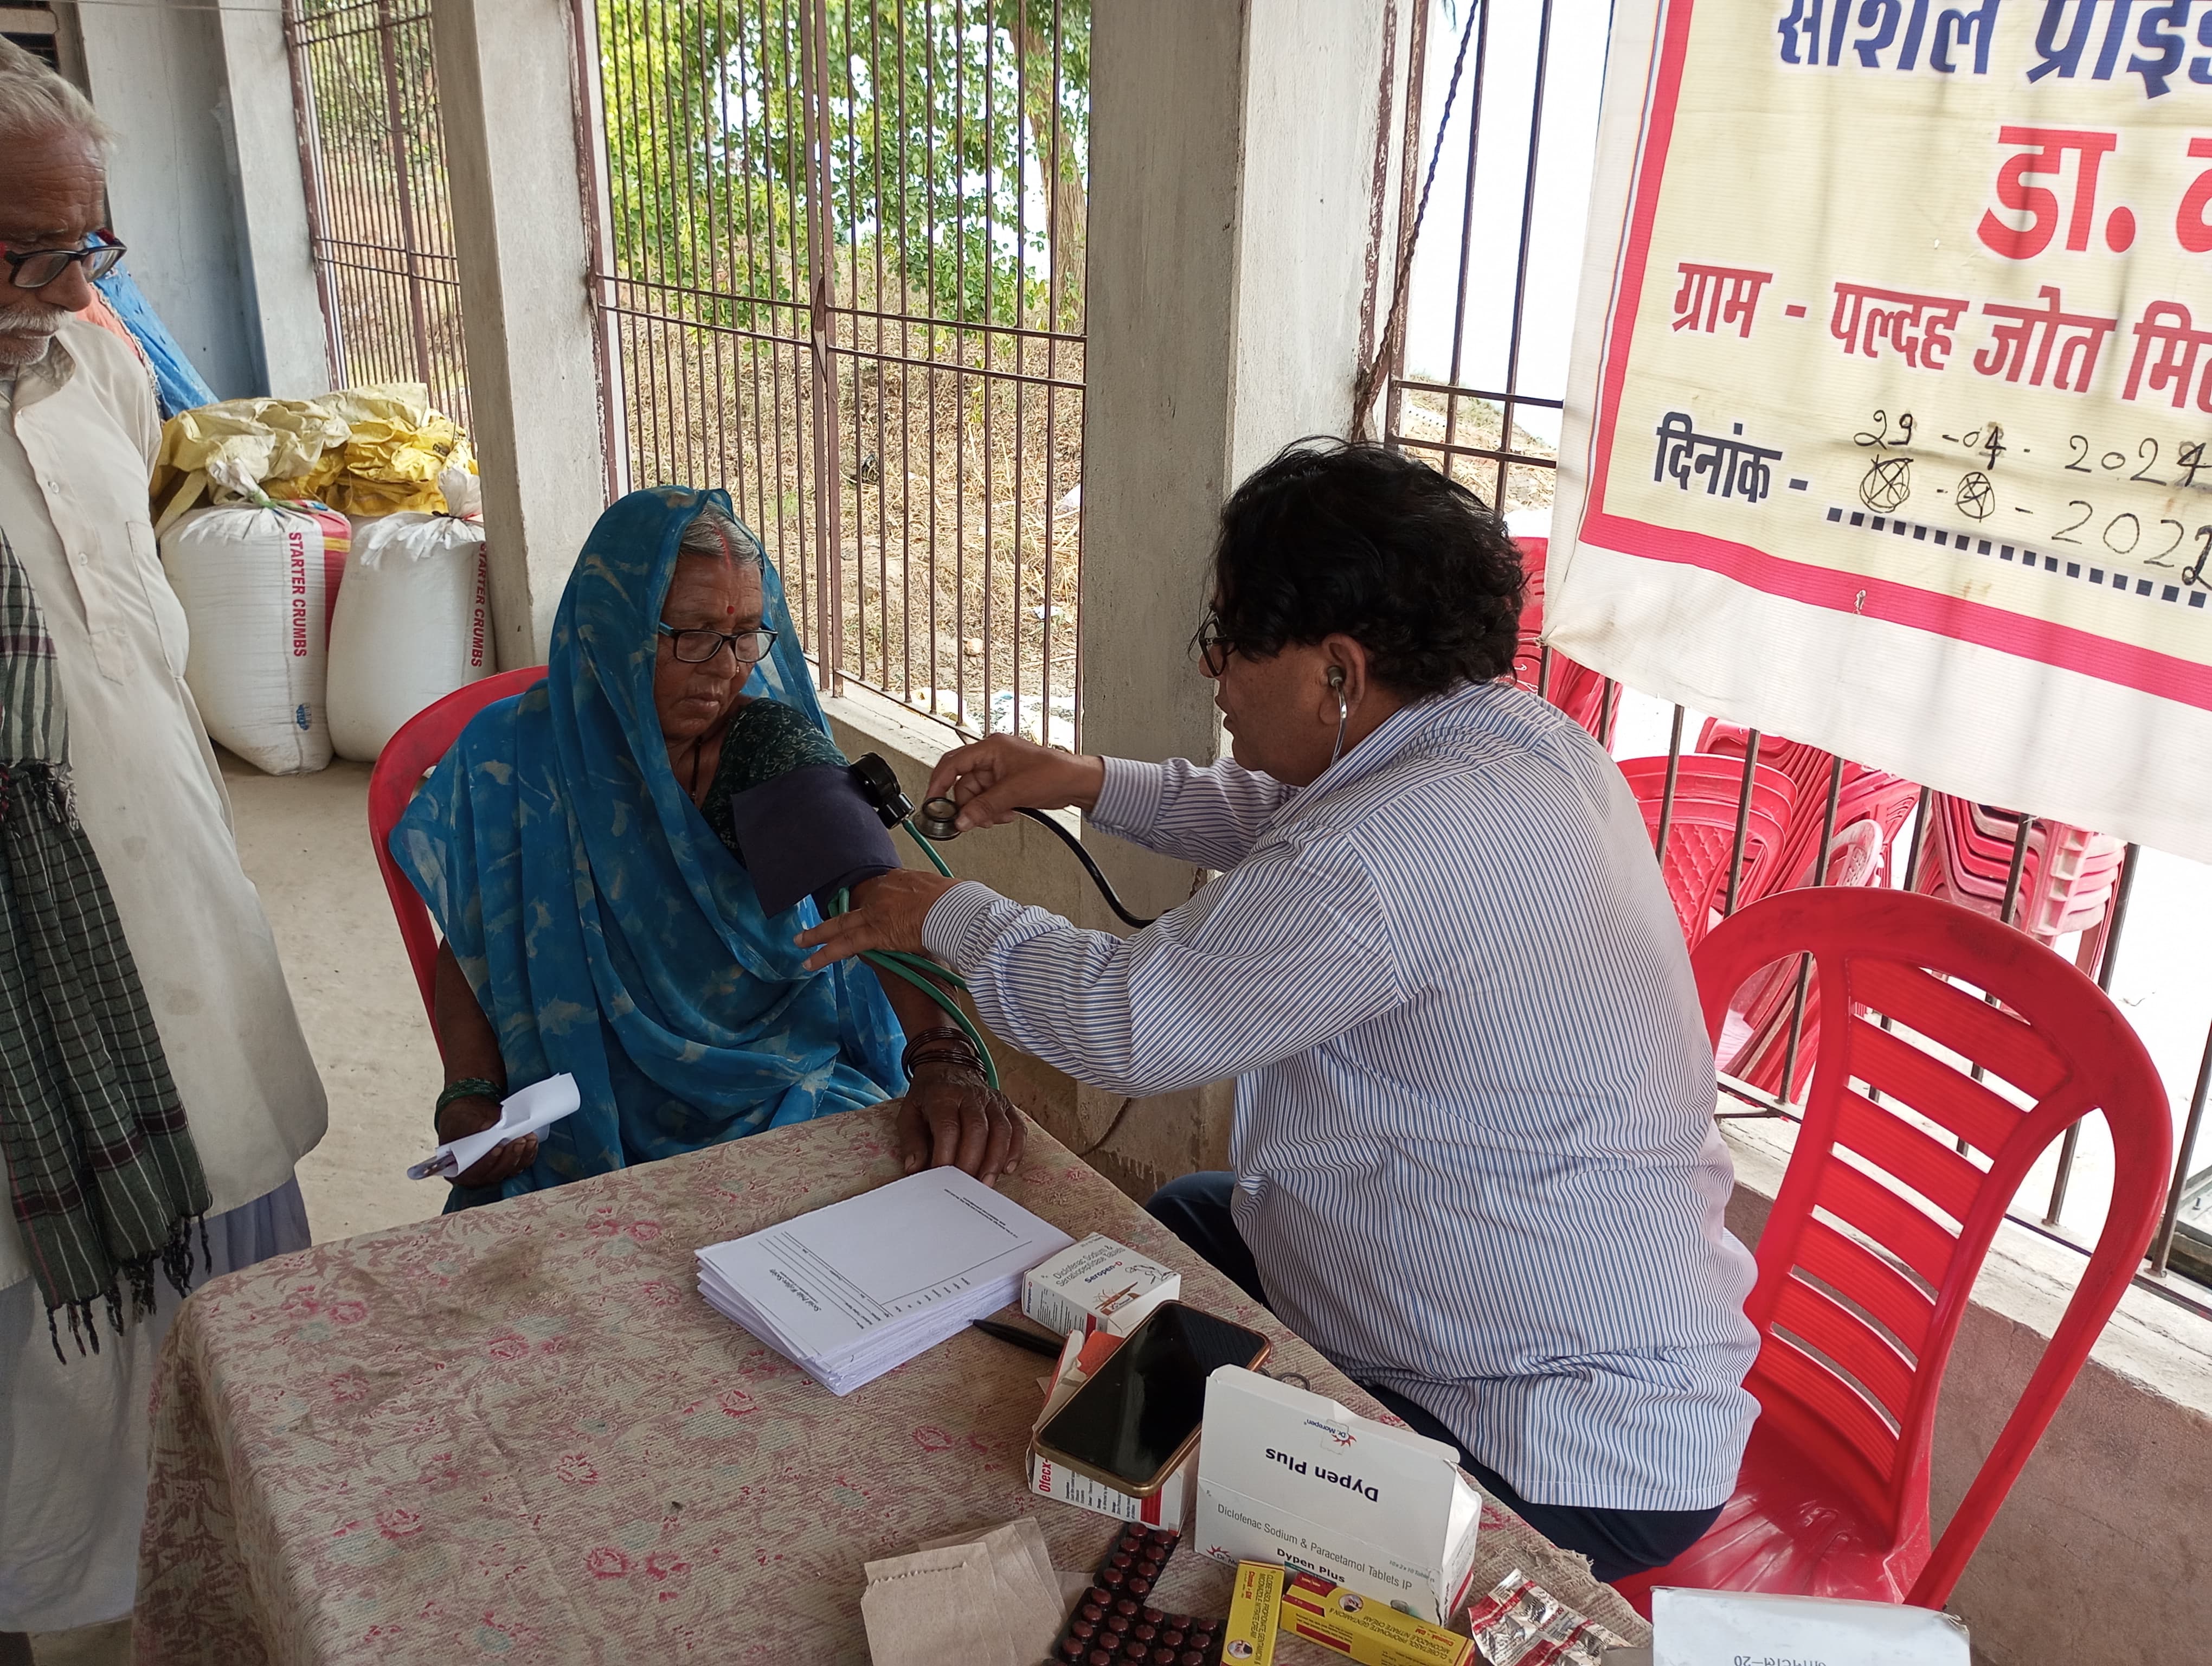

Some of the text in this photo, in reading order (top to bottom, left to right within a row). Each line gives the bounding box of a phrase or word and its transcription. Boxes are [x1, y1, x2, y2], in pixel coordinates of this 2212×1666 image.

[1977, 125, 2136, 260] डा.
[1671, 262, 1773, 337] ग्राम
[1973, 285, 2118, 393] जोत
[1654, 411, 1783, 503] दिनांक
[289, 532, 307, 657] STARTER CRUMBS
[471, 542, 487, 668] STARTER CRUMBS
[1084, 1261, 1123, 1283] Seropen-D
[1306, 1419, 1347, 1438] Dr. Morepen
[1265, 1448, 1379, 1502] Dypen Plus
[1218, 1503, 1412, 1591] Diclofenac Sodium & Paracetamol Tablets IP
[1277, 1548, 1315, 1571] Dypen
[1319, 1566, 1346, 1583] Plus
